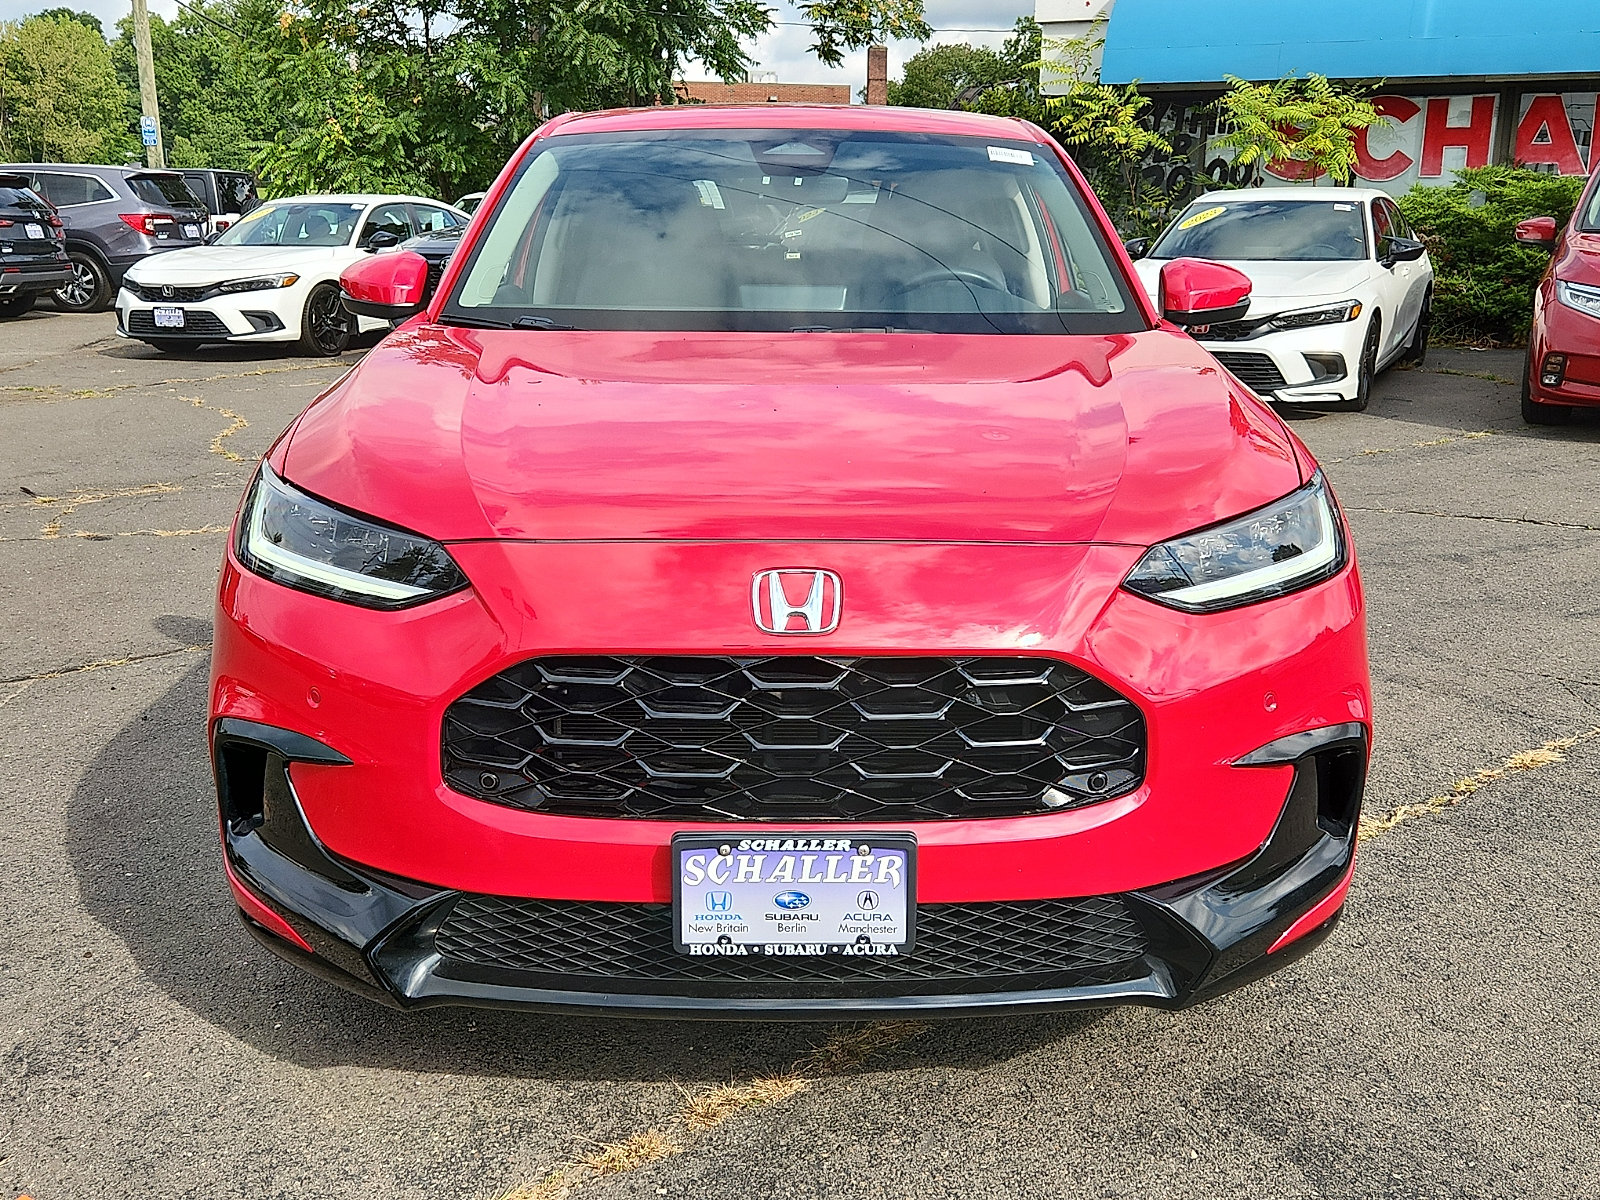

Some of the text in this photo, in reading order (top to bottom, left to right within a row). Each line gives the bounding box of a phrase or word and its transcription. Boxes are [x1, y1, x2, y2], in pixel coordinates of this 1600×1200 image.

[737, 839, 851, 852] SCHALLER
[683, 854, 903, 889] SCHALLER
[842, 913, 893, 922] ACURA
[688, 923, 749, 933] New Britain
[777, 922, 807, 933] Berlin
[838, 923, 898, 934] Manchester
[689, 943, 898, 956] HONDA SUBARU ACURA
